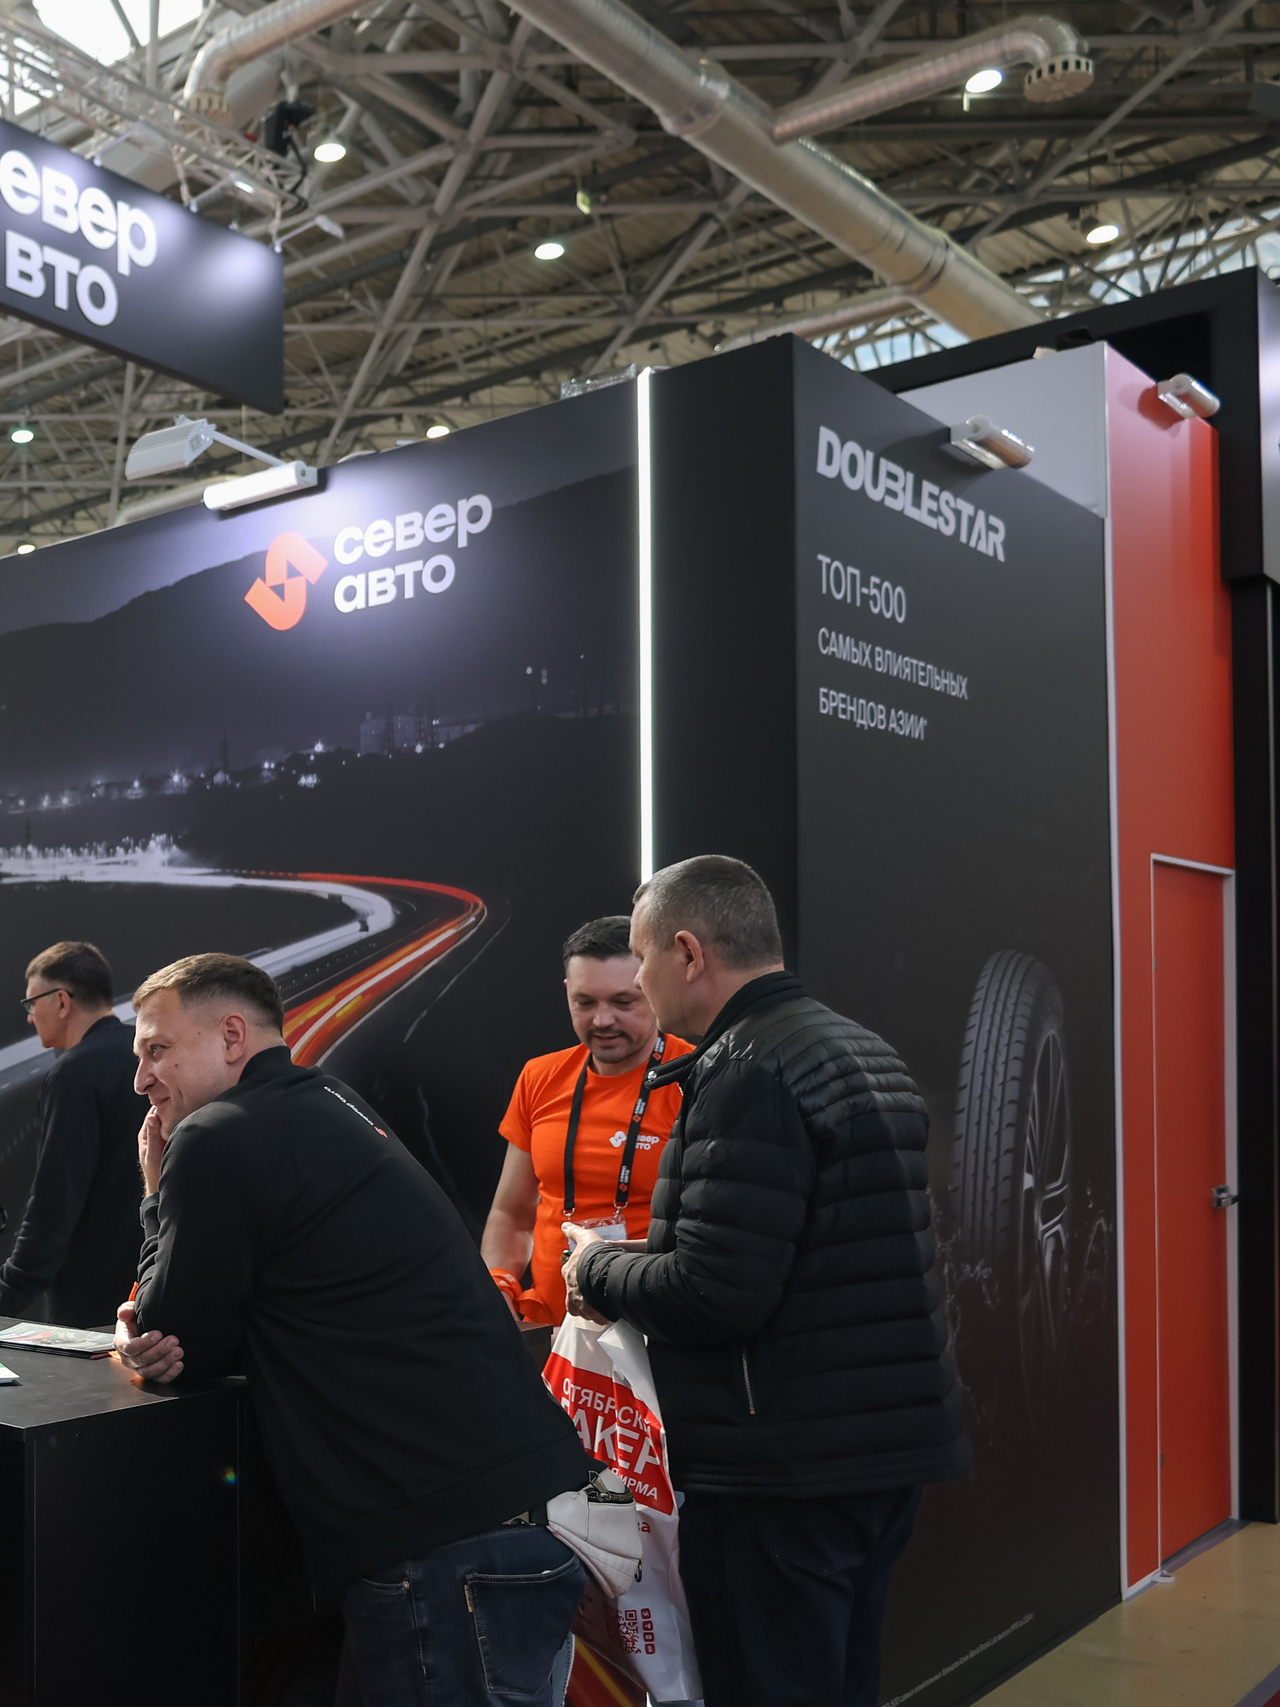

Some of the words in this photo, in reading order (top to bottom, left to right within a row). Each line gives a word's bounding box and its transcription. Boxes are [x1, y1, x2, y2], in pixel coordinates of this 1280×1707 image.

[333, 493, 493, 565] север
[816, 425, 1007, 563] DOUBLESTAR
[333, 554, 456, 614] авто
[817, 553, 907, 624] ТОП-500
[818, 627, 873, 670] САМЫХ
[874, 646, 969, 701] ВЛИЯТЕЛЬНЫХ
[819, 687, 887, 731] БРЕНДОВ
